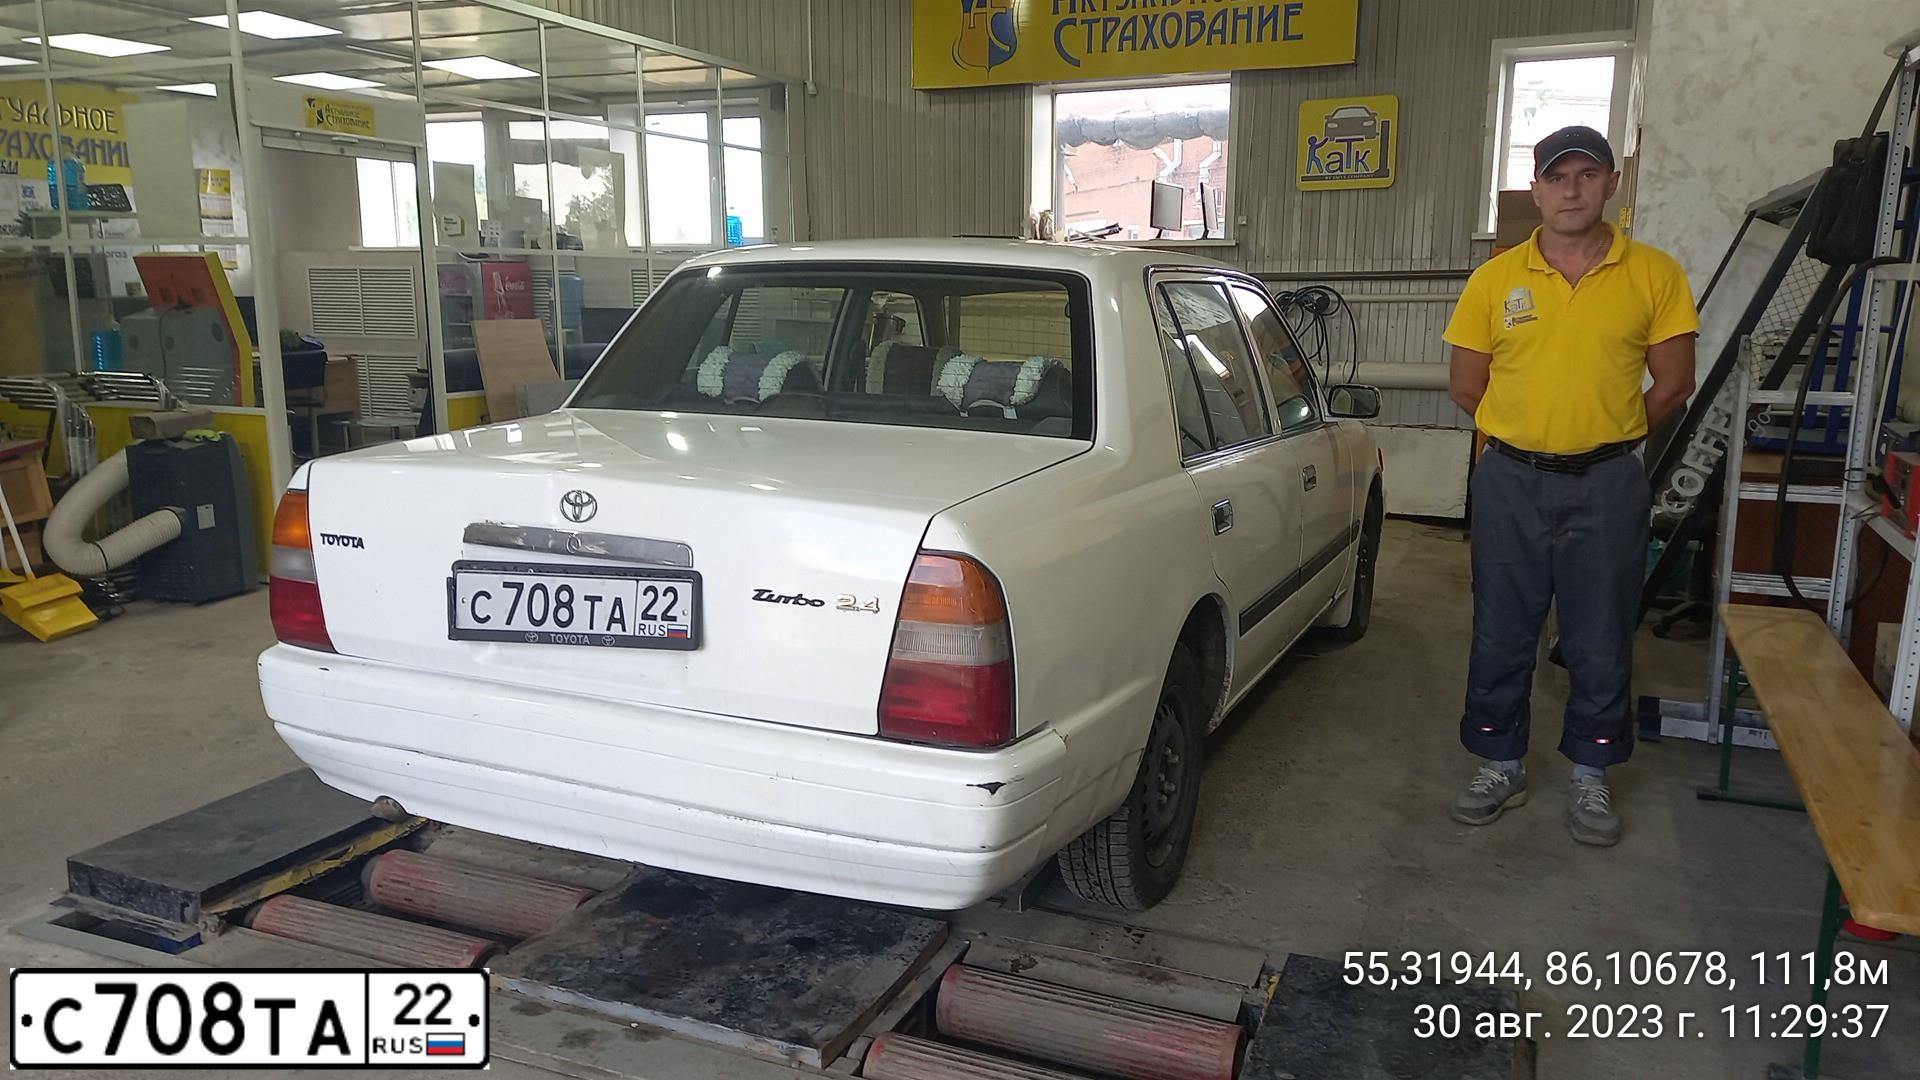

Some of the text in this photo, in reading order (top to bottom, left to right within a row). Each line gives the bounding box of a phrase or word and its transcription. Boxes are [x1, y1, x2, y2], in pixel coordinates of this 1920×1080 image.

[1053, 3, 1304, 67] СТРАХОВАНИЕ
[0, 97, 119, 134] УАЬНОЕ
[320, 533, 365, 549] TOYOTA
[641, 585, 679, 622] 22
[752, 588, 825, 607] Turbo
[550, 633, 590, 645] TOYOTA
[638, 624, 666, 636] RUS
